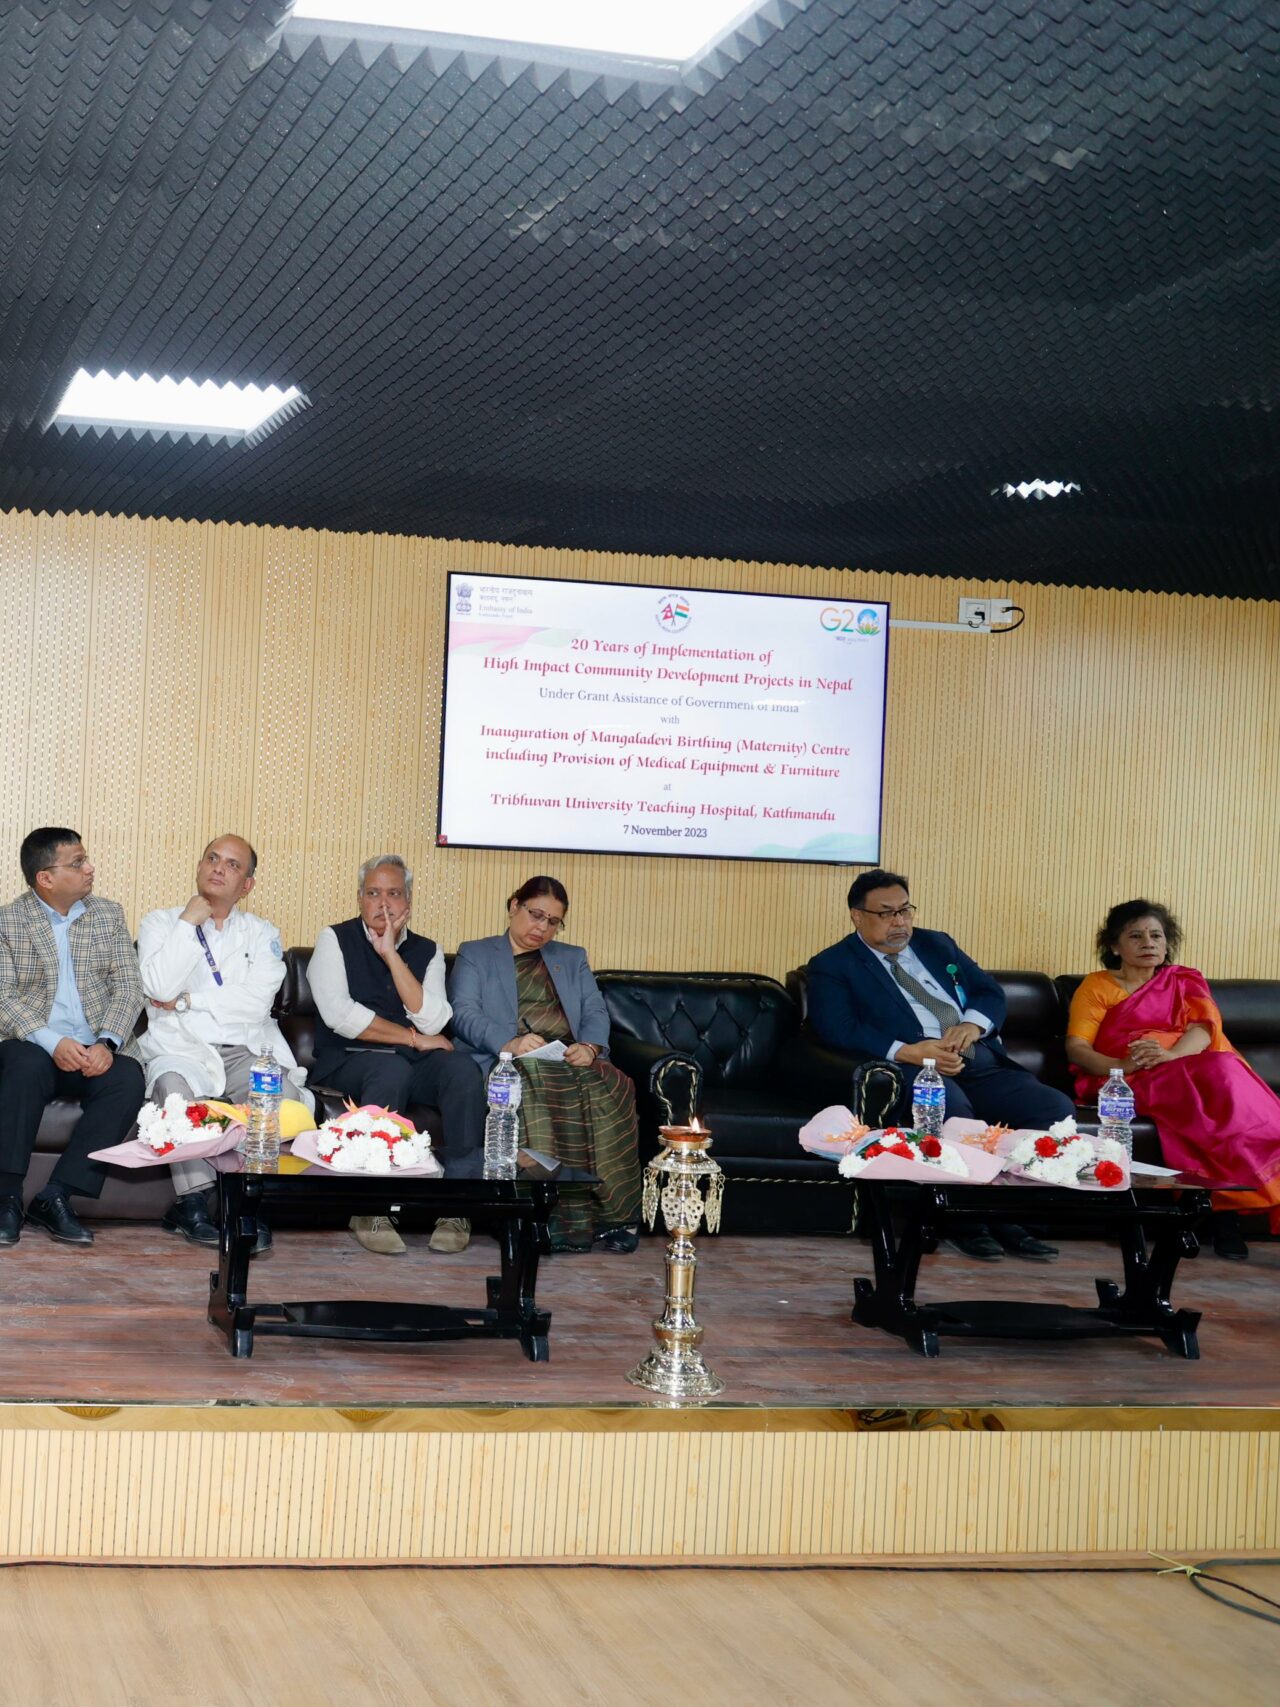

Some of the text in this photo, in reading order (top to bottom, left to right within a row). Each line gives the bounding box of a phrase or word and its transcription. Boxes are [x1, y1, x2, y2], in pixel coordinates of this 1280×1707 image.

[571, 638, 774, 667] 20 Years of Implementation of
[483, 656, 853, 695] High Impact Community Development Projects in Nepal
[539, 687, 574, 701] Under
[577, 690, 609, 703] Grant
[612, 691, 668, 706] Assistance
[671, 694, 684, 706] of
[685, 695, 753, 710] Government
[660, 714, 680, 725] with
[480, 725, 850, 757] Inauguration of Mangaladevi Birthing (Maternity) Centre
[485, 747, 840, 778] including Provision of Medical Equipment & Furniture
[663, 782, 672, 792] at
[490, 792, 836, 821] Tribhuvan University Teaching Hospital, Kathmandu
[623, 824, 708, 838] 7 November 2023
